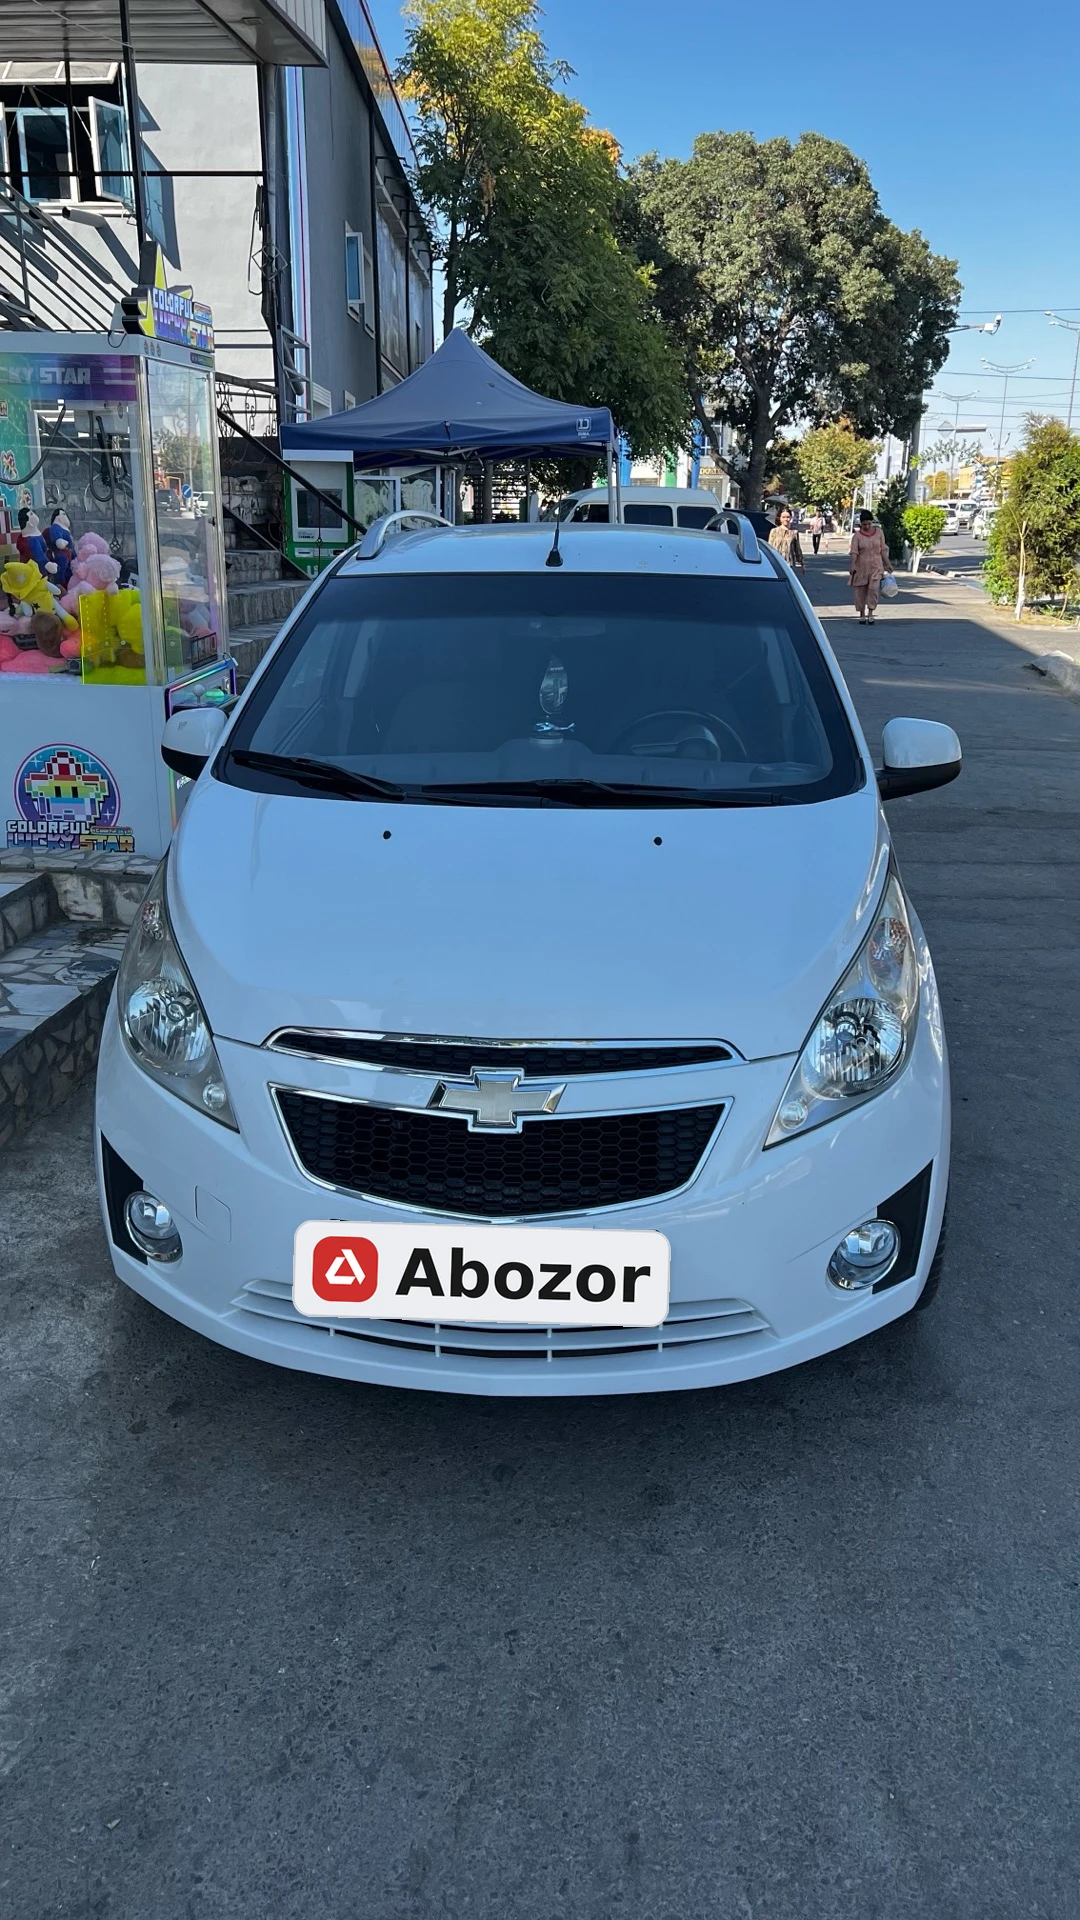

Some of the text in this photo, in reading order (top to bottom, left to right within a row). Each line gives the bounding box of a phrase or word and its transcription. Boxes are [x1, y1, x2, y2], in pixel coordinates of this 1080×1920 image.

[152, 287, 194, 320] COLORFUL
[154, 308, 190, 345] LUCKY
[188, 319, 214, 351] STAR
[40, 367, 91, 385] STAR
[7, 820, 90, 834] COLORFUL
[7, 833, 135, 852] LUCKY STAR
